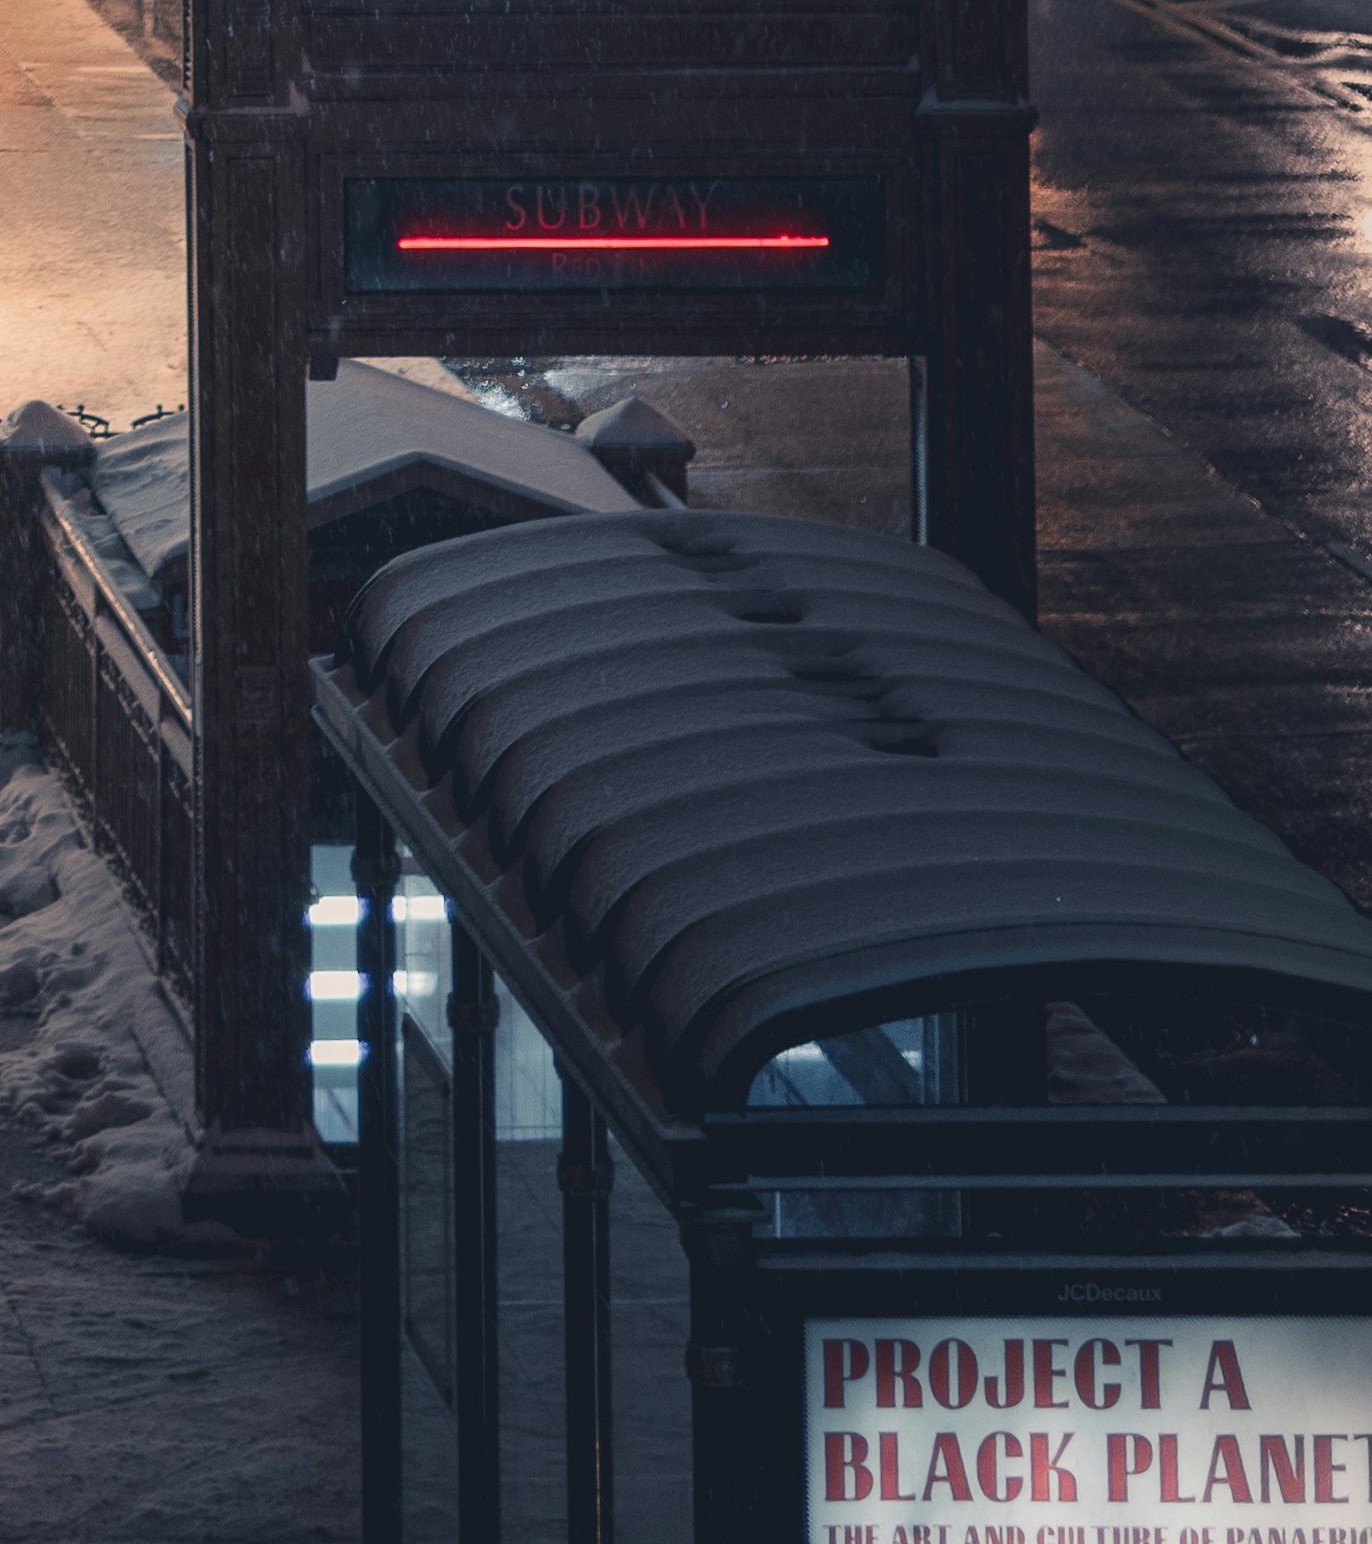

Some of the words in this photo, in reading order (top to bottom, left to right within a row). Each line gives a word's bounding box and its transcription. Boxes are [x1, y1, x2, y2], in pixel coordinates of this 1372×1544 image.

[504, 182, 715, 232] SUBWAY
[1057, 1283, 1163, 1304] JCDecaux
[822, 1337, 1174, 1410] PROJECT
[1199, 1338, 1253, 1411] A
[822, 1430, 1078, 1503] BLACK
